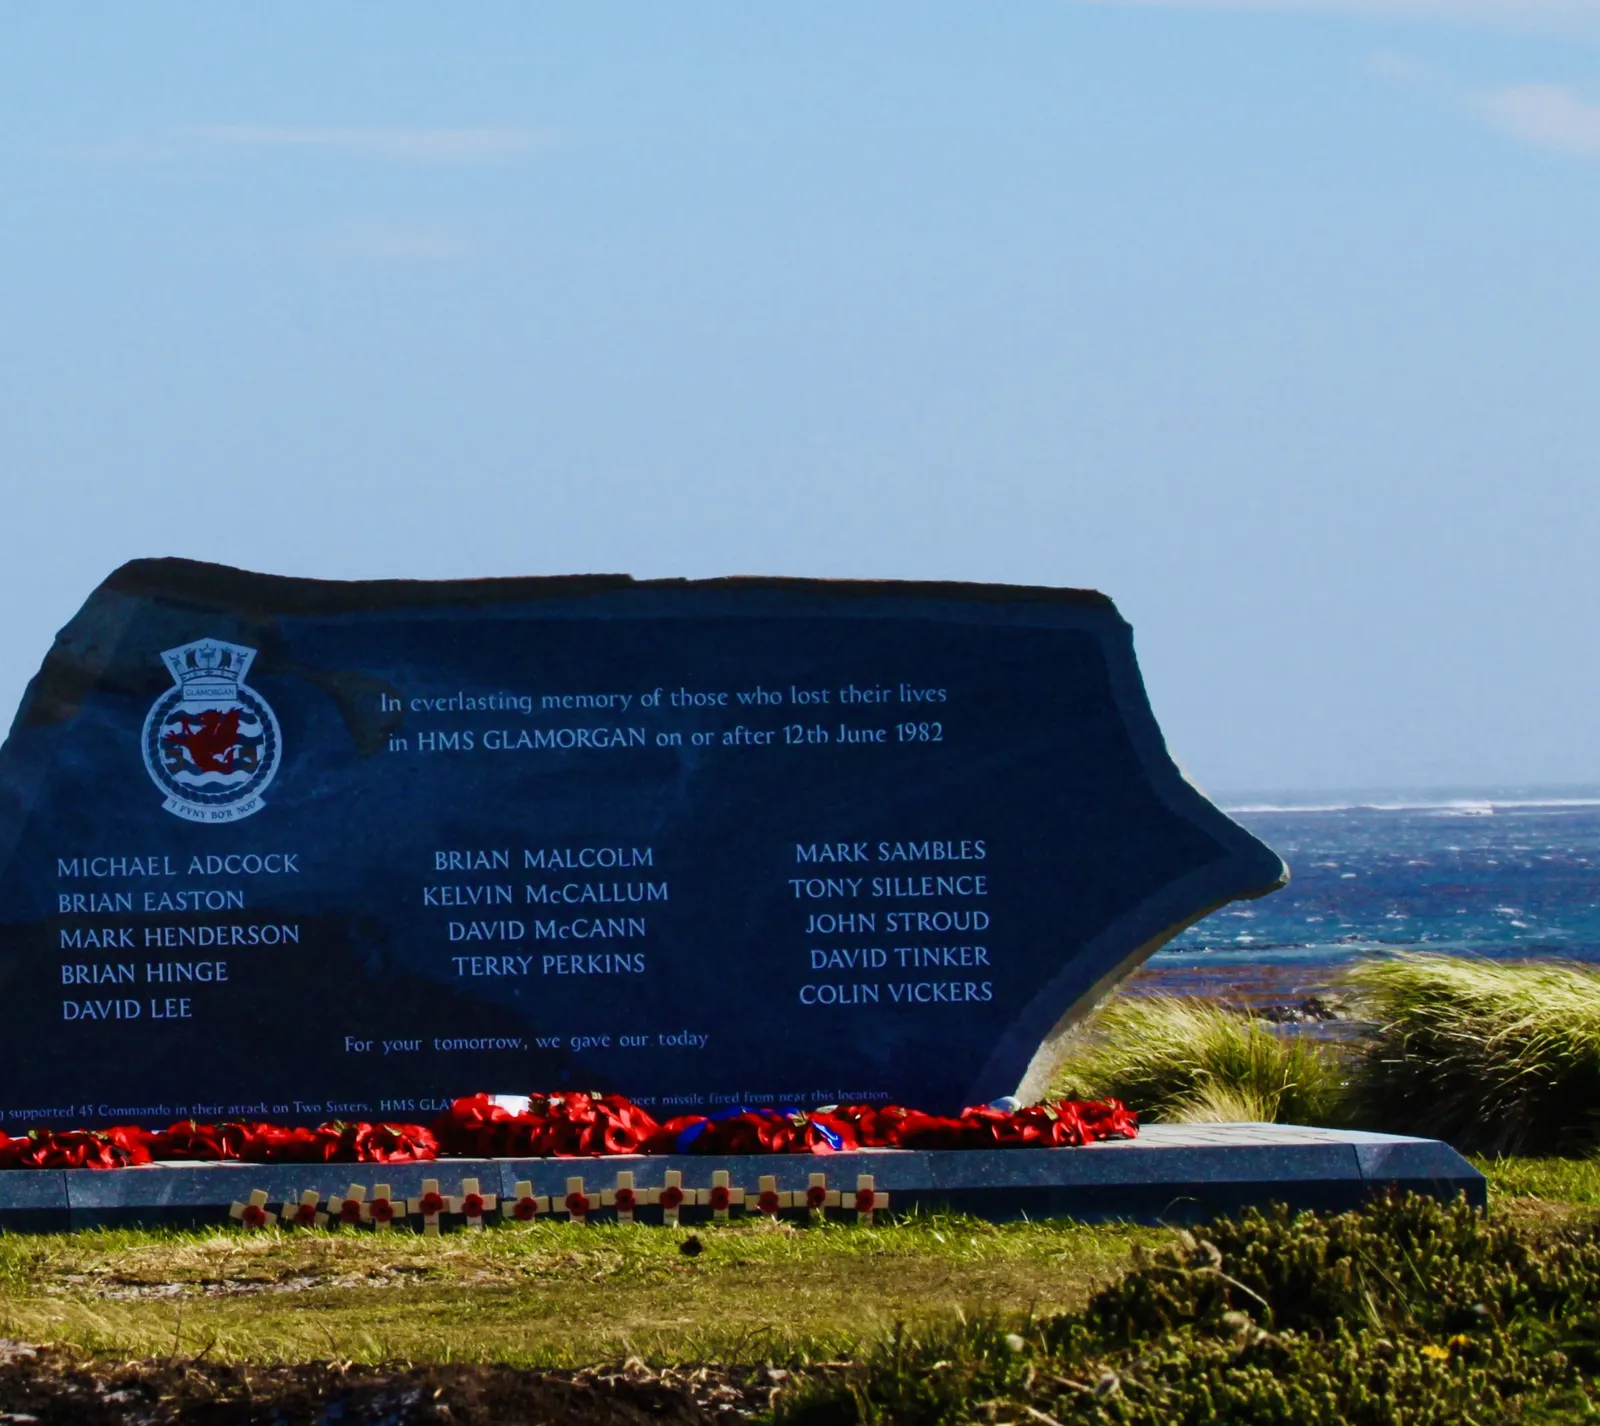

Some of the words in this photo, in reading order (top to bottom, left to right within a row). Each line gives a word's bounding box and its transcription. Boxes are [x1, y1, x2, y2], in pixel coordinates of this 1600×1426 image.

[381, 692, 402, 713] In
[410, 690, 532, 714] everlasting
[541, 694, 633, 712] memory
[640, 687, 664, 707] of
[670, 687, 729, 707] those
[736, 684, 783, 705] who
[791, 685, 831, 705] lost
[839, 683, 892, 704] their
[899, 683, 947, 703] lives
[389, 733, 408, 753] in
[417, 729, 475, 751] HMS
[482, 726, 646, 750] GLAMORGAN
[655, 732, 683, 747] on
[691, 731, 715, 747] or
[722, 725, 776, 746] after
[782, 723, 829, 745] 12th
[836, 723, 887, 744] June
[895, 720, 943, 743] 1982
[434, 849, 509, 871] BRIAN
[524, 847, 654, 871] MALCOLM
[795, 841, 870, 863] MARK
[878, 839, 987, 862] SAMBLES
[57, 855, 177, 878] MICHAEL
[187, 853, 300, 875] ADCOCK
[423, 884, 513, 907] KELVIN
[525, 881, 669, 904] McCALLUM
[787, 877, 864, 899] TONY
[871, 875, 988, 898] SILLENCE
[58, 892, 132, 914] BRIAN
[143, 889, 244, 912] EASTON
[448, 920, 525, 941] DAVID
[534, 917, 646, 940] McCANN
[805, 912, 876, 934] JOHN
[886, 910, 990, 933] STROUD
[59, 927, 135, 950] MARK
[144, 923, 299, 947] HENDERSON
[451, 955, 534, 976] TERRY
[542, 952, 645, 975] PERKINS
[810, 947, 887, 969] DAVID
[893, 945, 991, 968] TINKER
[61, 963, 135, 985] BRIAN
[146, 960, 229, 983] HINGE
[799, 983, 879, 1005] COLIN
[887, 980, 993, 1003] VICKERS
[62, 999, 141, 1021] DAVID
[150, 997, 193, 1019] LEE
[344, 1036, 374, 1053] For
[382, 1039, 423, 1056] your
[433, 1037, 528, 1051] tomorrow,
[535, 1036, 561, 1049] we
[570, 1035, 611, 1052] gave
[619, 1035, 650, 1048] our
[658, 1029, 709, 1049] today
[661, 1092, 705, 1105] missile
[709, 1090, 740, 1104] fired
[744, 1090, 775, 1104] from
[779, 1092, 806, 1103] near
[811, 1089, 835, 1101] this
[837, 1089, 894, 1101] location.
[8, 1104, 75, 1121] supported
[78, 1104, 94, 1117] 45
[97, 1103, 171, 1117] Commando
[174, 1103, 188, 1116] in
[191, 1102, 224, 1116] their
[227, 1101, 269, 1115] attack
[272, 1103, 289, 1114] on
[292, 1100, 322, 1114] Two
[326, 1100, 373, 1113] Sisters,
[379, 1098, 416, 1112] HMS
